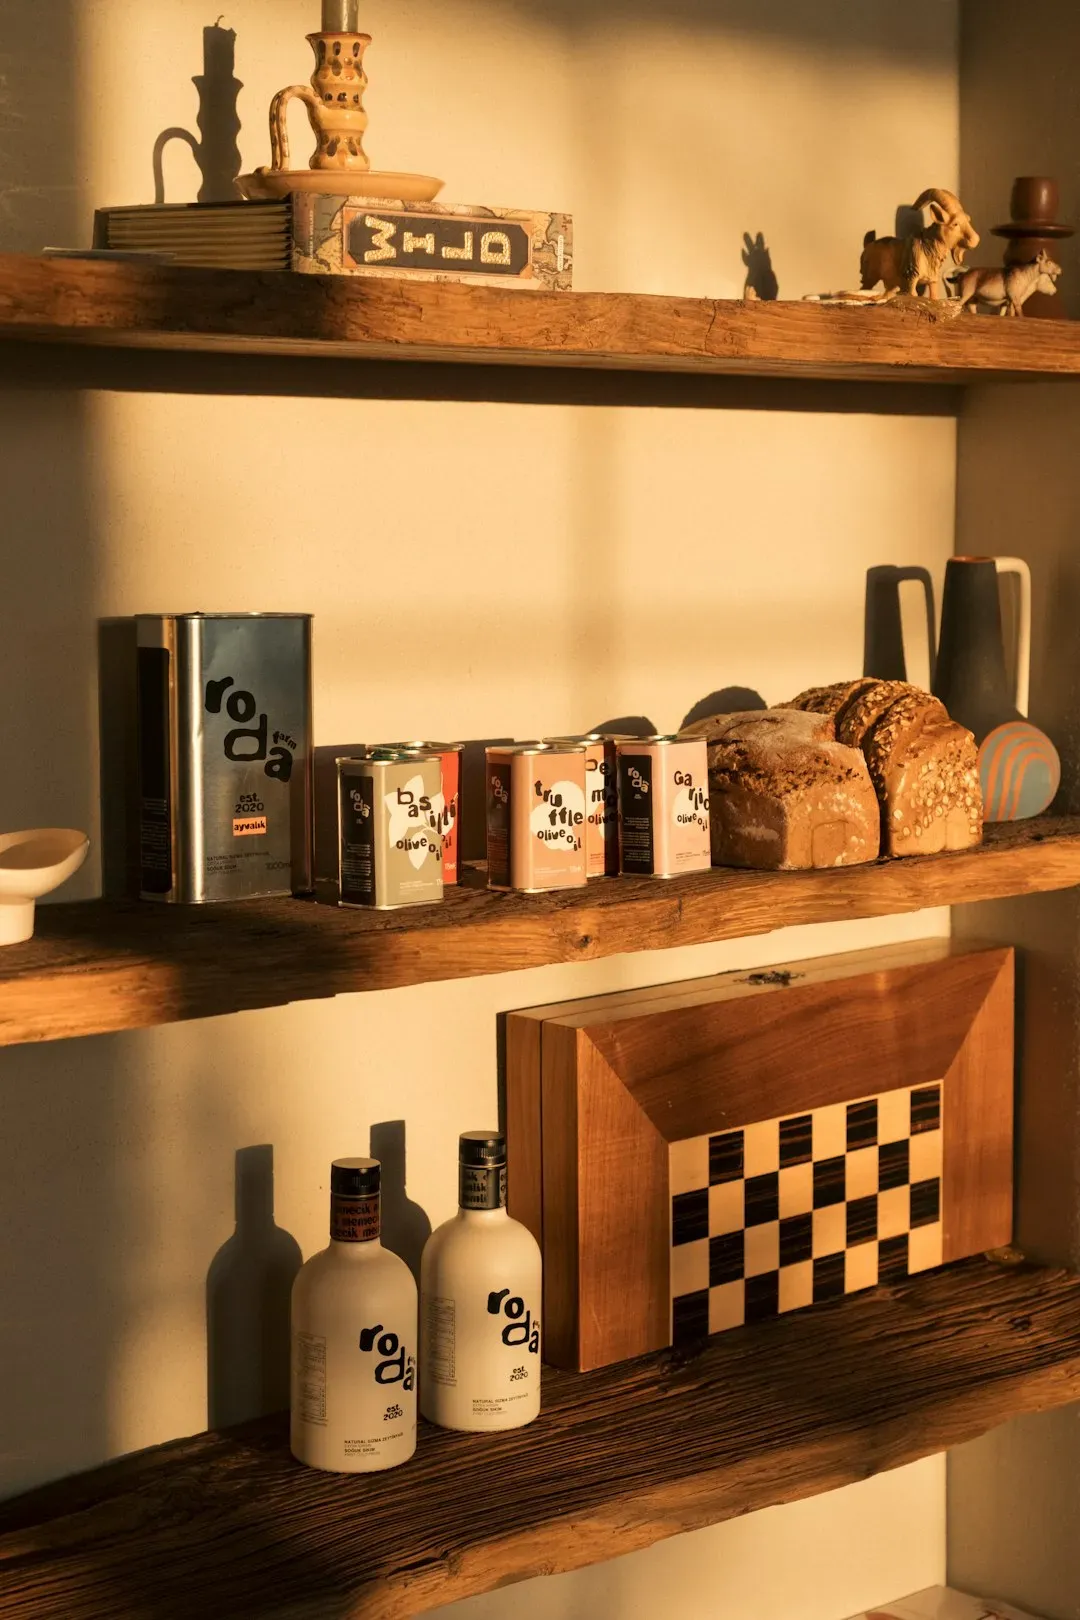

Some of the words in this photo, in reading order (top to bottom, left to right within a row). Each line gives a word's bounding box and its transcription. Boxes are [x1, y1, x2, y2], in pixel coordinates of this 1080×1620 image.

[364, 215, 510, 265] WILD
[205, 676, 293, 782] roda
[272, 731, 297, 750] farm
[235, 802, 265, 813] 2020
[677, 813, 698, 824] olive
[396, 837, 428, 851] olive
[537, 829, 566, 841] olive
[566, 835, 582, 851] oil
[487, 1288, 539, 1354] roda
[359, 1324, 415, 1391] roda
[510, 1371, 528, 1382] 2020
[383, 1409, 404, 1421] 2020
